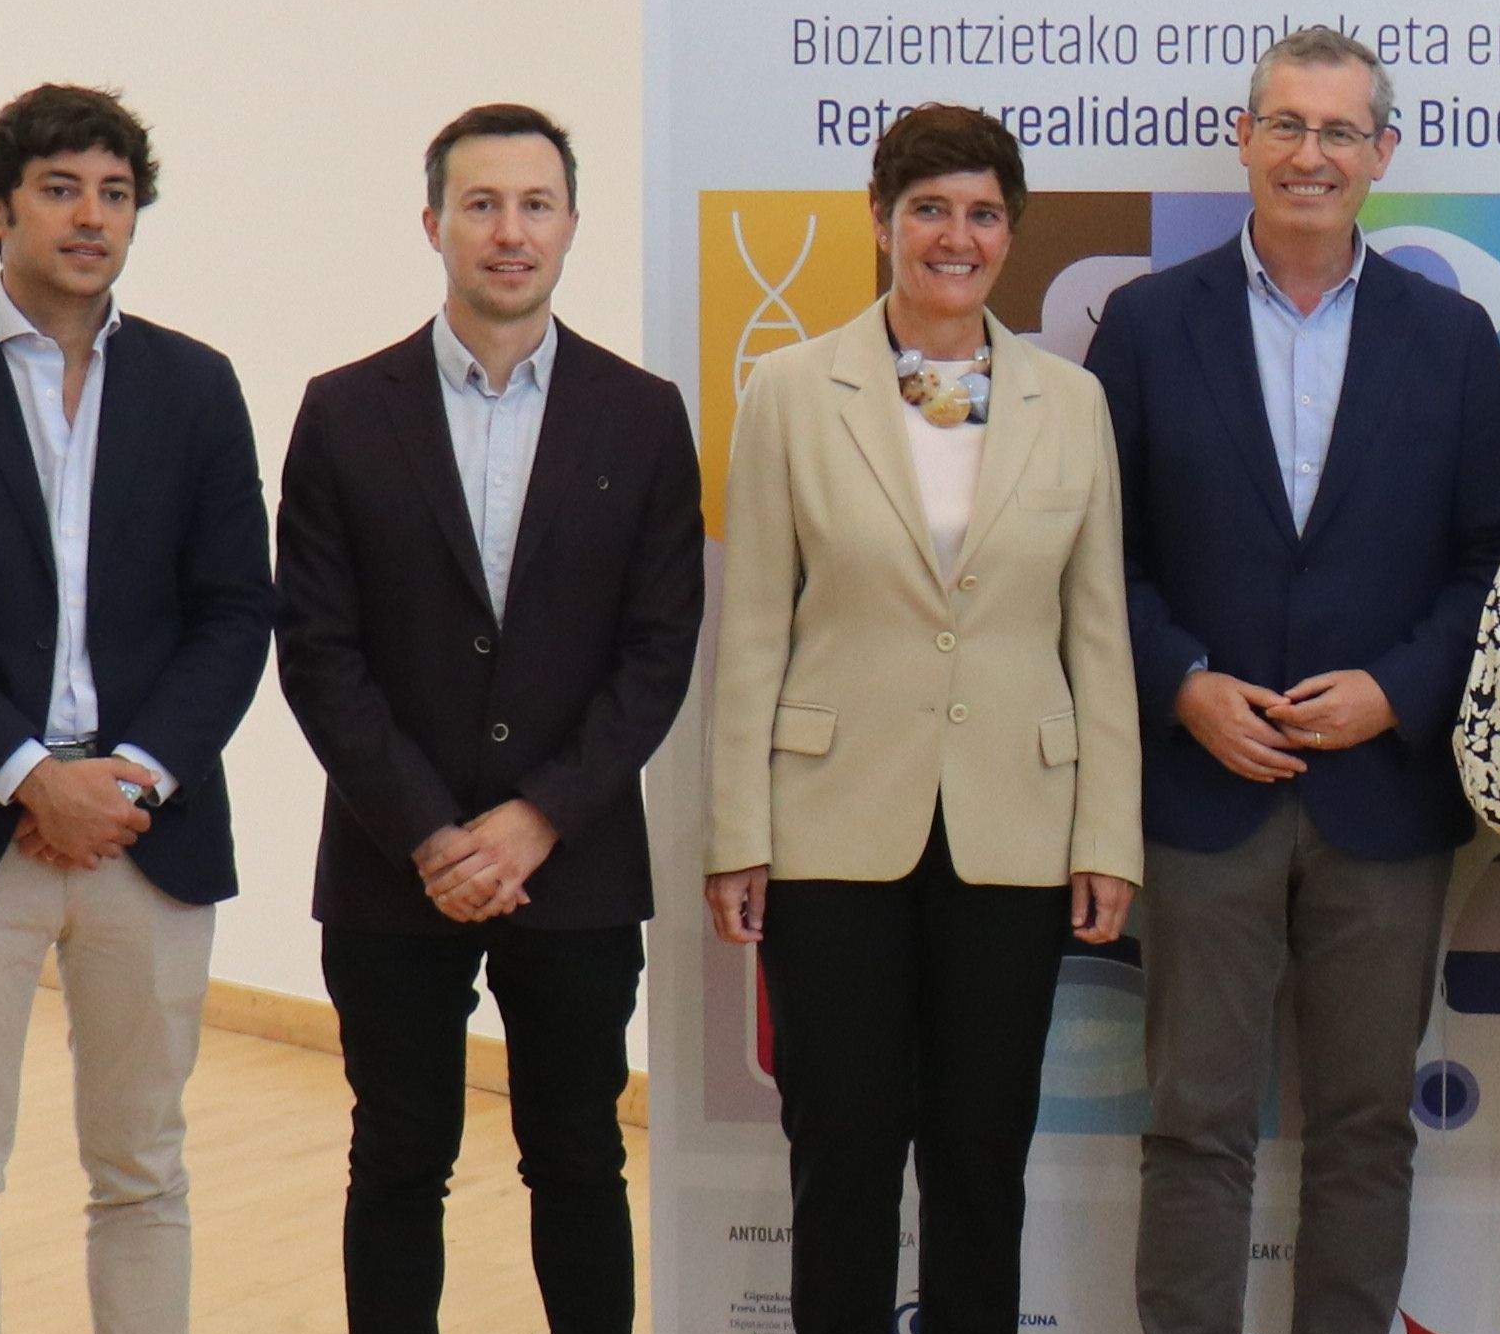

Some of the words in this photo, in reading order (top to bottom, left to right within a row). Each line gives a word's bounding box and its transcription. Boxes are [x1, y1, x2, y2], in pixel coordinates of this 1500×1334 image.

[793, 15, 1138, 66] Biozientzietako
[1156, 14, 1360, 66] erron
[1377, 17, 1449, 66] eta
[817, 98, 912, 147] Ret
[1001, 97, 1244, 147] realidades
[729, 1226, 793, 1243] ANTOLAT
